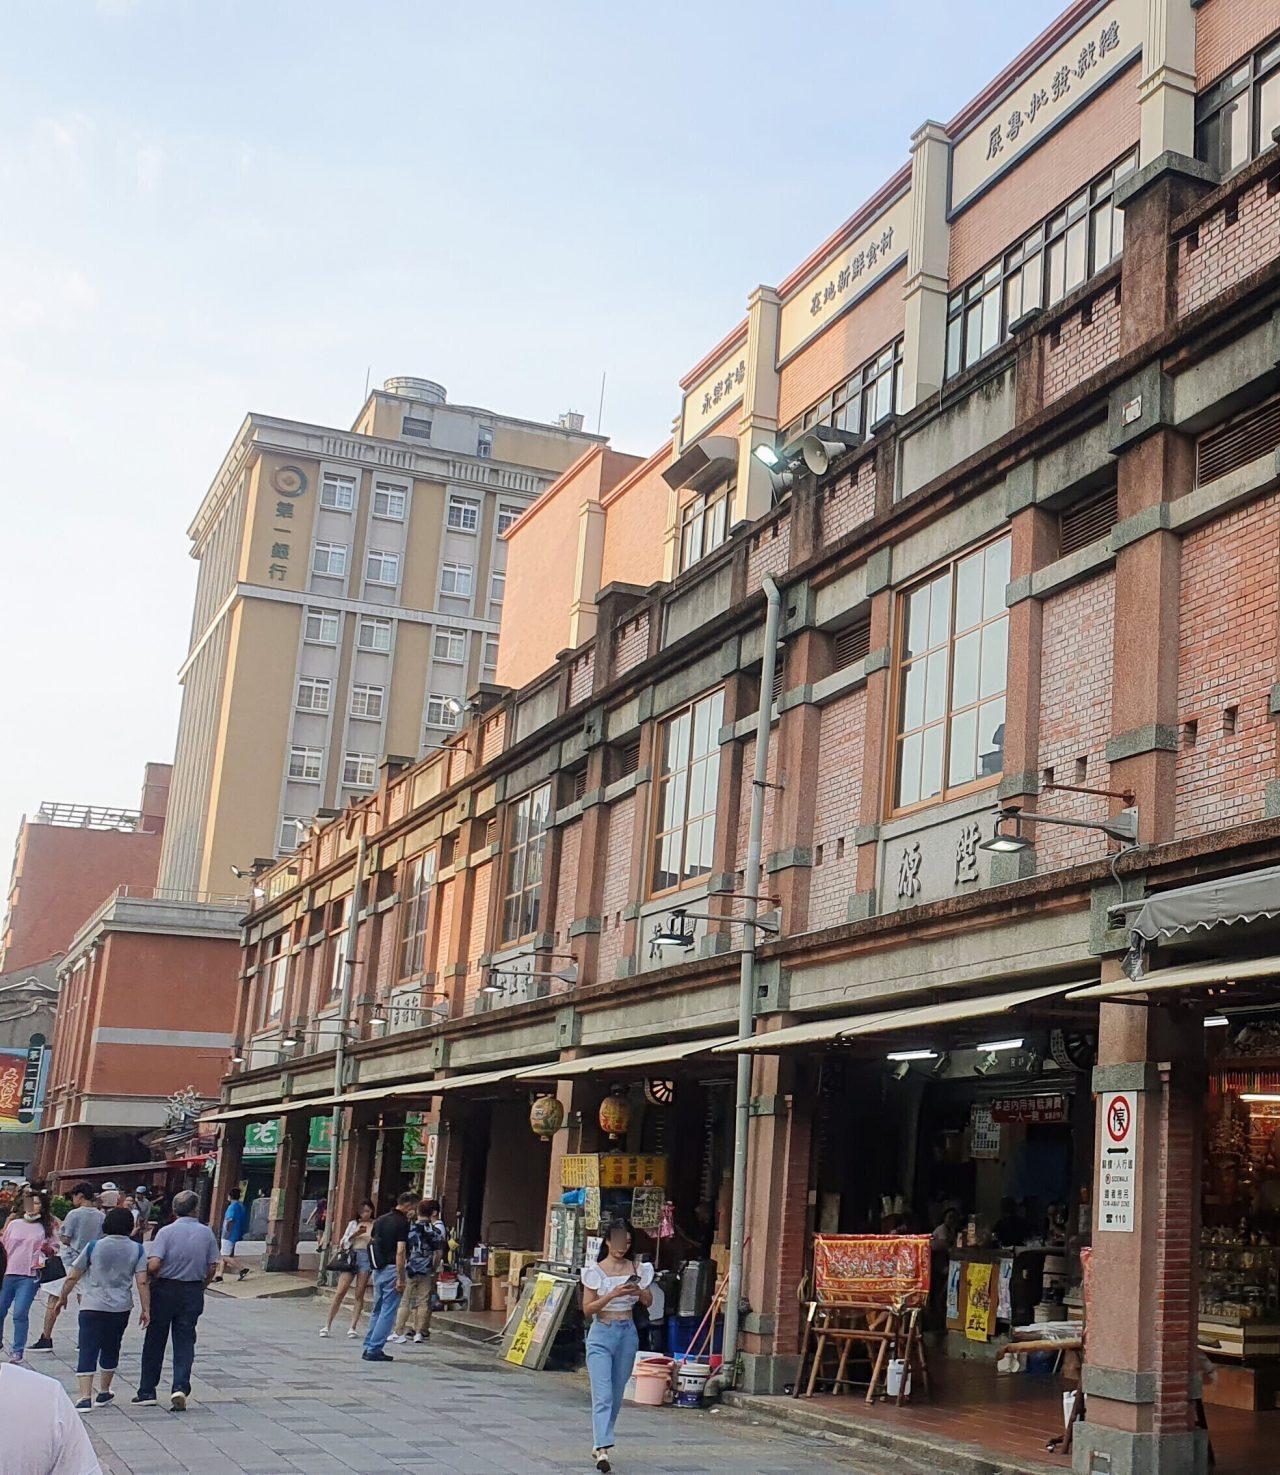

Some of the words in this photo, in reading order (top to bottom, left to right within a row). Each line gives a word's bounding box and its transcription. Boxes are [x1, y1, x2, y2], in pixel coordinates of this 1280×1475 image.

[809, 226, 894, 316] 在地新鮮食材
[701, 359, 746, 415] 永樂市場
[268, 501, 294, 581] 第一銀行
[1112, 1107, 1125, 1132] 停
[1114, 1213, 1127, 1225] 110
